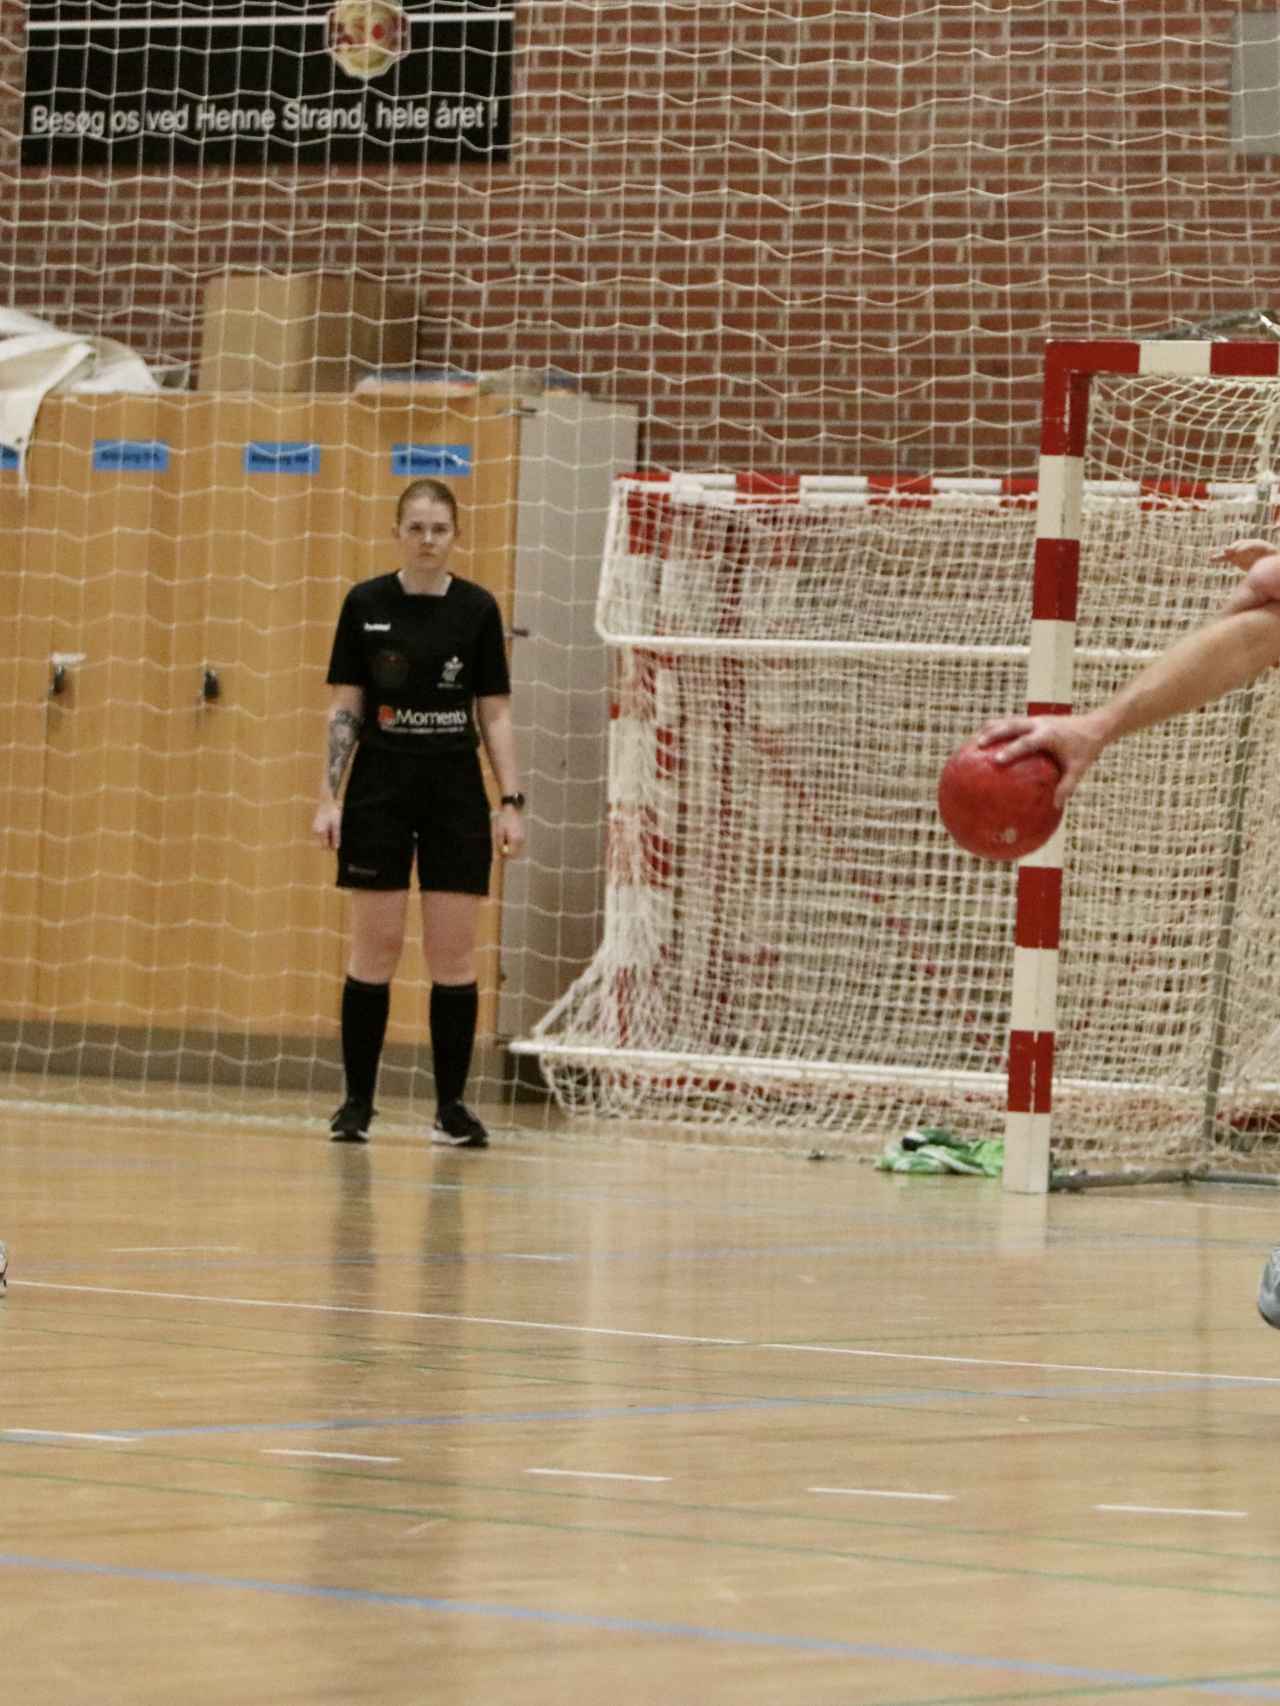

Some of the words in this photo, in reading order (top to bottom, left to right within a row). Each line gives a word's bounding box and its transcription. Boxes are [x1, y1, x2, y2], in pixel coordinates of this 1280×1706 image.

[31, 105, 105, 137] Besøg
[110, 109, 140, 132] os
[147, 103, 189, 132] ved
[196, 103, 276, 131] Henne
[376, 101, 429, 130] hele
[435, 100, 485, 130] året
